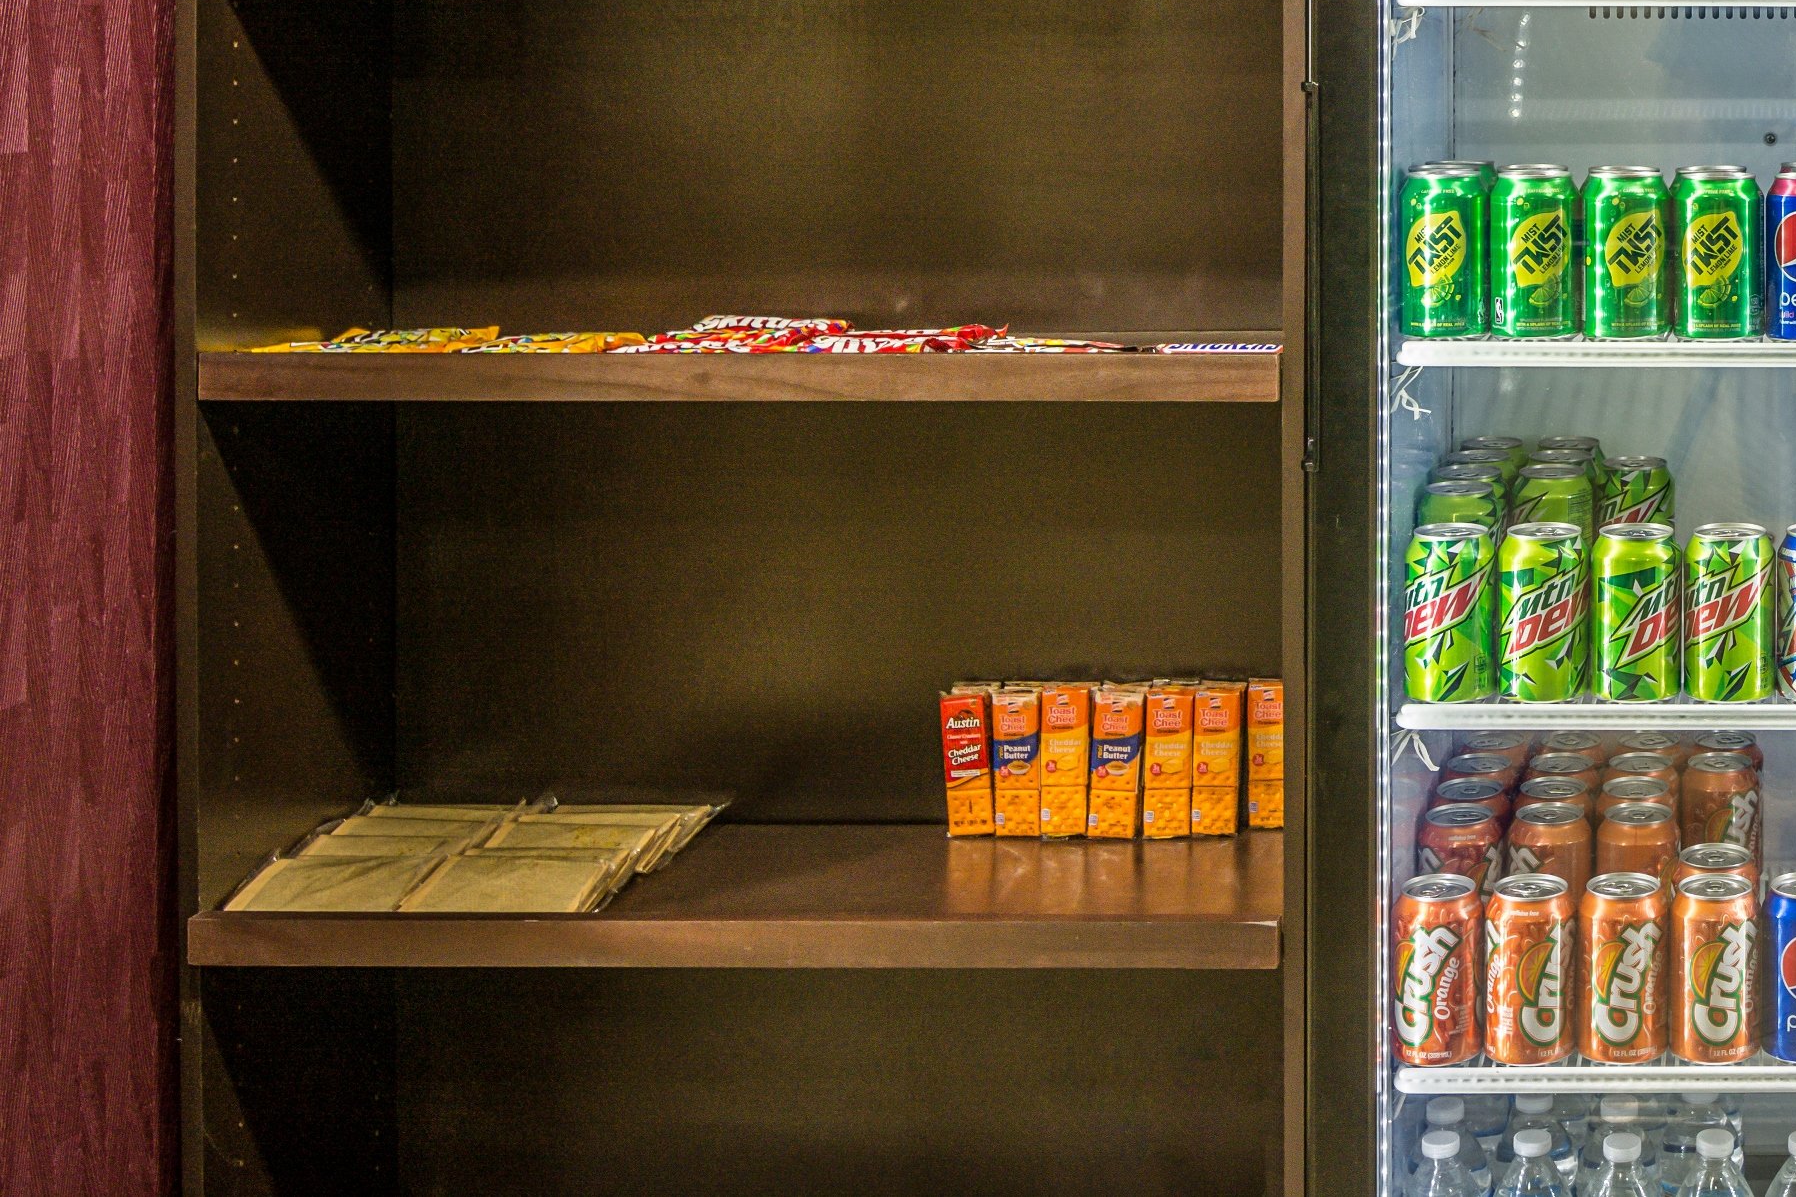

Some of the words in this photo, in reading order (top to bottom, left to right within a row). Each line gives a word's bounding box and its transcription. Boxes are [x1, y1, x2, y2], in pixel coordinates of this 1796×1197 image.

[1521, 223, 1541, 243] MIST
[1616, 222, 1636, 243] MIST
[1691, 224, 1708, 244] MIST
[1513, 214, 1568, 275] TWIST
[1608, 214, 1662, 275] TWIST
[1707, 256, 1727, 275] LEMON
[1724, 244, 1738, 261] LIME
[1048, 706, 1076, 715] Toast
[1048, 715, 1075, 724] Chee
[946, 717, 980, 729] Austin
[948, 744, 982, 759] Cheddar
[1103, 744, 1131, 752] Peanut
[1103, 752, 1129, 760] Butter
[952, 753, 979, 766] Cheese
[1395, 927, 1459, 1044] Crush
[1434, 956, 1460, 1020] Orange
[1594, 922, 1662, 1043] Crush
[1694, 920, 1758, 1043] Crush
